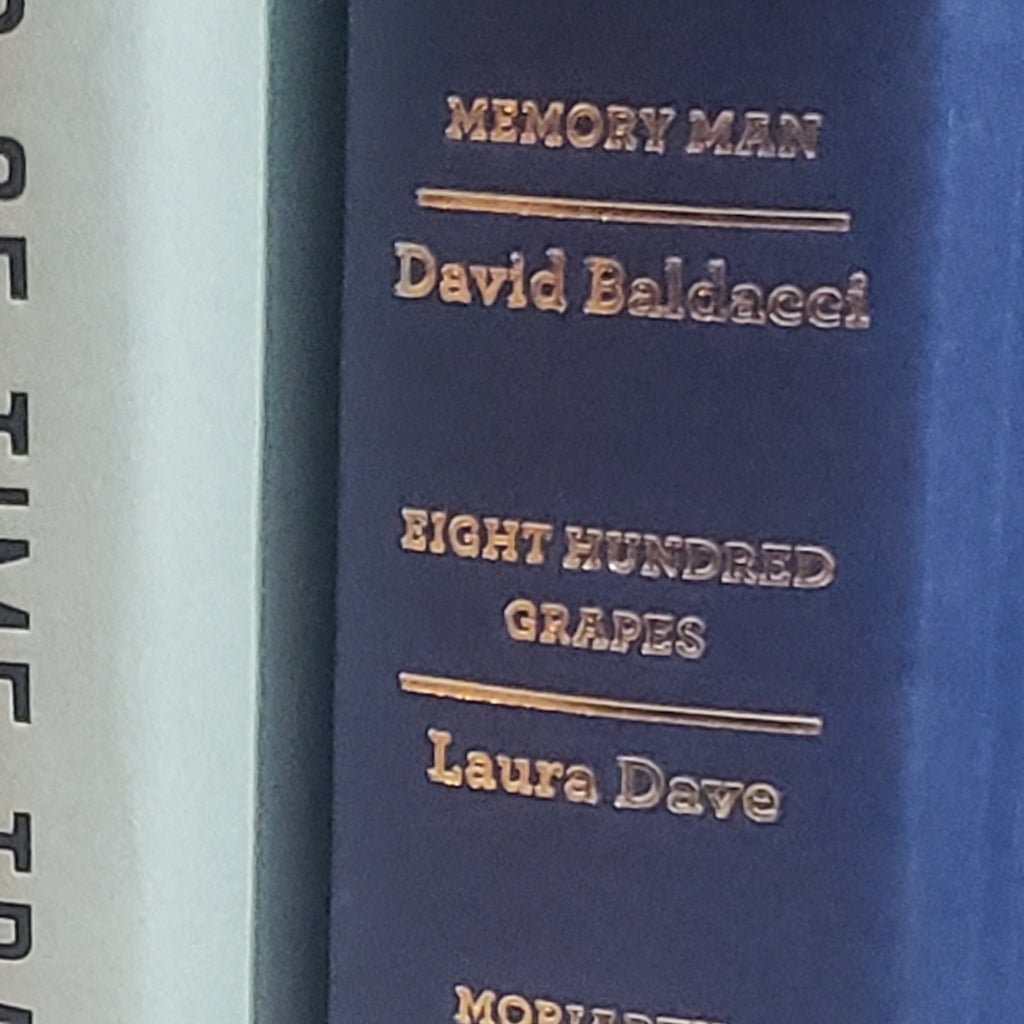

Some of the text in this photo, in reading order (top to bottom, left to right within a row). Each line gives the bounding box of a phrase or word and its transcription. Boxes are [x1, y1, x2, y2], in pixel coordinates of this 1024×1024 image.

[445, 95, 823, 159] MEMORY MAN
[393, 240, 872, 330] David Baldacci
[400, 508, 837, 589] EIGHT HUNDRED
[504, 598, 707, 660] GRAPES
[427, 728, 783, 823] Laura Dave
